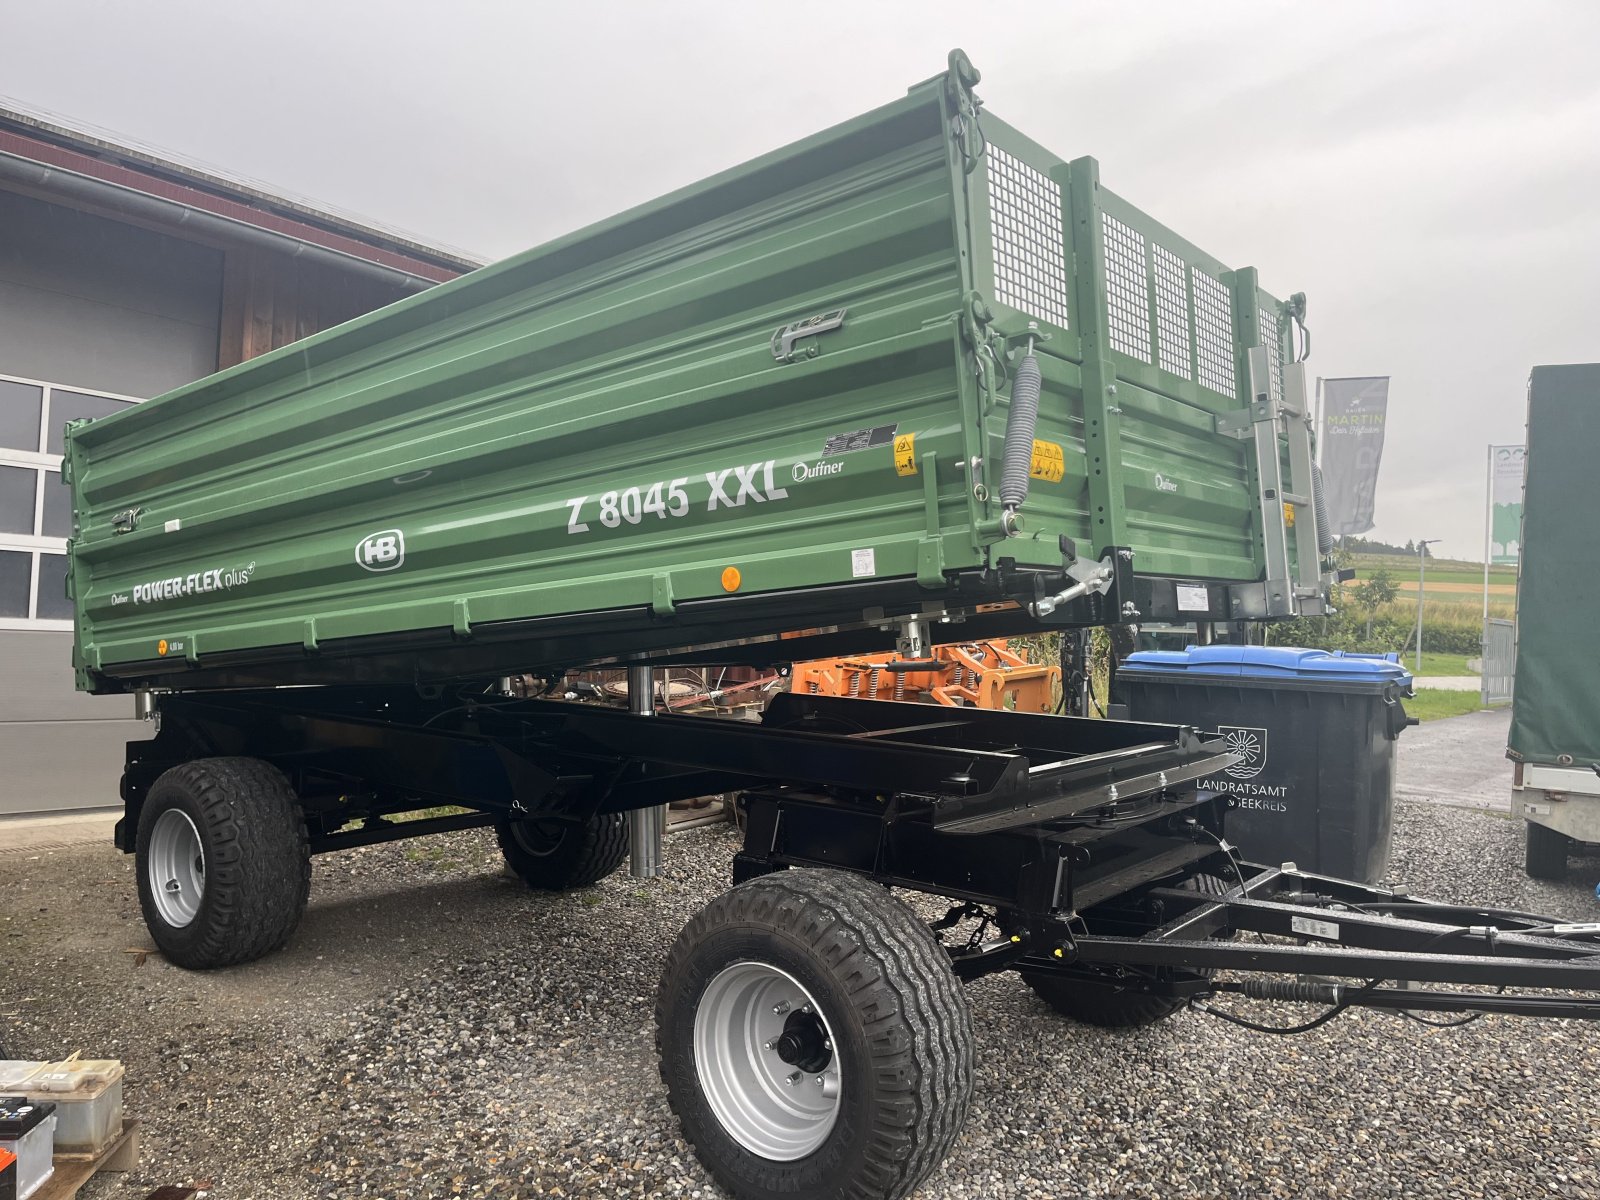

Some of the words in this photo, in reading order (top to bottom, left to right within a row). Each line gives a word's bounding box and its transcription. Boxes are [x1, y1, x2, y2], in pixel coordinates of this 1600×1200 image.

[1327, 414, 1384, 426] MARTIN
[792, 461, 844, 483] Duffner
[565, 495, 590, 535] Z
[599, 477, 690, 529] 8045
[704, 459, 789, 512] XXL
[1196, 778, 1288, 798] LANDRATSAMT
